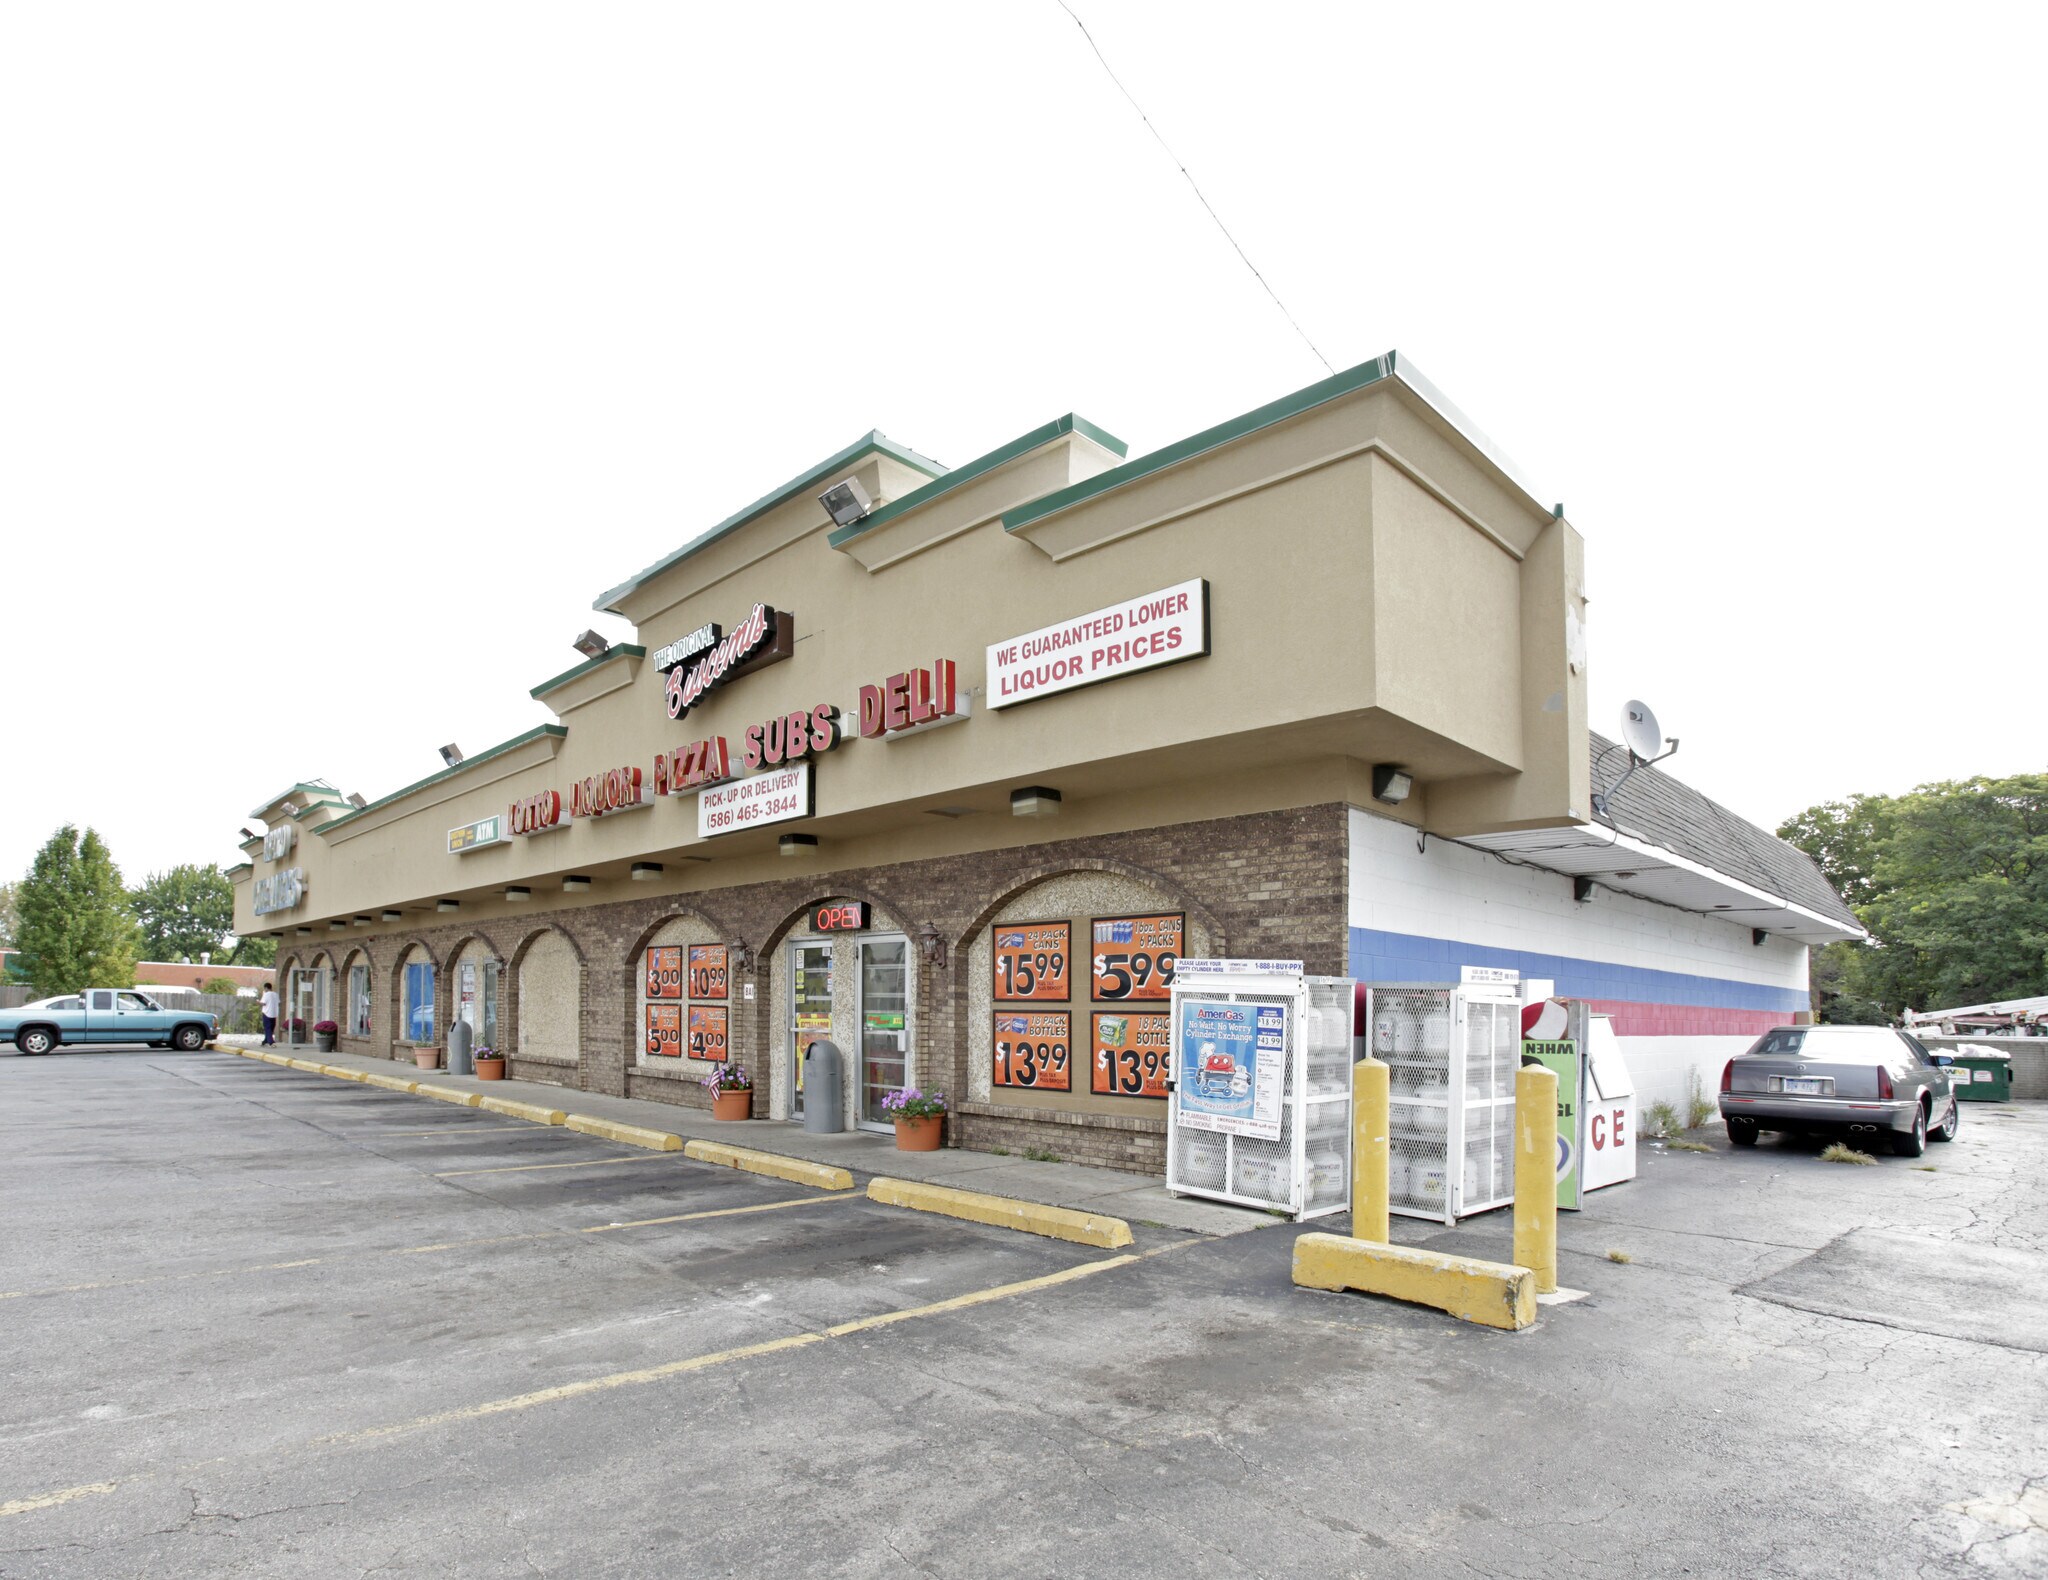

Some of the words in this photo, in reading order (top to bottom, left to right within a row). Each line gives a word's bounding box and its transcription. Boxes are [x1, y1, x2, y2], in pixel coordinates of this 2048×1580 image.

[997, 646, 1017, 667] WE
[1022, 613, 1123, 658] GUARANTEED
[1129, 592, 1189, 627] LOWER
[653, 647, 670, 672] THE
[671, 623, 715, 663] ORIGINAL
[666, 603, 768, 720] Buscemi's
[1001, 655, 1083, 696] LIQUOR
[1091, 626, 1183, 670] PRICES
[859, 658, 955, 739] DELI
[743, 703, 839, 769] SUBS
[653, 735, 730, 796] PIZZA
[568, 765, 640, 818] LIQUOR
[704, 784, 739, 809] PICK-UP
[741, 783, 753, 799] OR
[755, 772, 799, 797] DELIVERY
[507, 789, 559, 835] LOTTO
[707, 810, 734, 830] (586)
[737, 795, 797, 822] 465-3844
[476, 821, 494, 842] ATM
[817, 907, 861, 930] OPEN
[1159, 919, 1182, 933] CANS
[1028, 931, 1040, 941] 24
[1042, 929, 1067, 940] PACK
[1140, 936, 1145, 949] 6
[1147, 934, 1175, 948] PACKS
[1033, 940, 1060, 950] CANS
[1032, 1016, 1041, 1026] 18
[1043, 1016, 1067, 1026] PACK
[1197, 1008, 1244, 1020] AmeriGas
[1139, 1017, 1149, 1030] 18
[1152, 1017, 1170, 1031] PAC
[1188, 1020, 1198, 1029] No
[1217, 1022, 1227, 1031] No
[1229, 1024, 1252, 1034] Worry
[1030, 1026, 1067, 1037] BOTTLES
[1185, 1029, 1216, 1039] Cylinder
[1218, 1032, 1253, 1043] Exchange
[1137, 1032, 1170, 1046] BOTTLE
[1526, 1043, 1574, 1054] WHEN
[1186, 1112, 1212, 1120] FLAMMABLE
[1193, 1120, 1212, 1129] SMOKING
[1217, 1124, 1237, 1133] PROPANE
